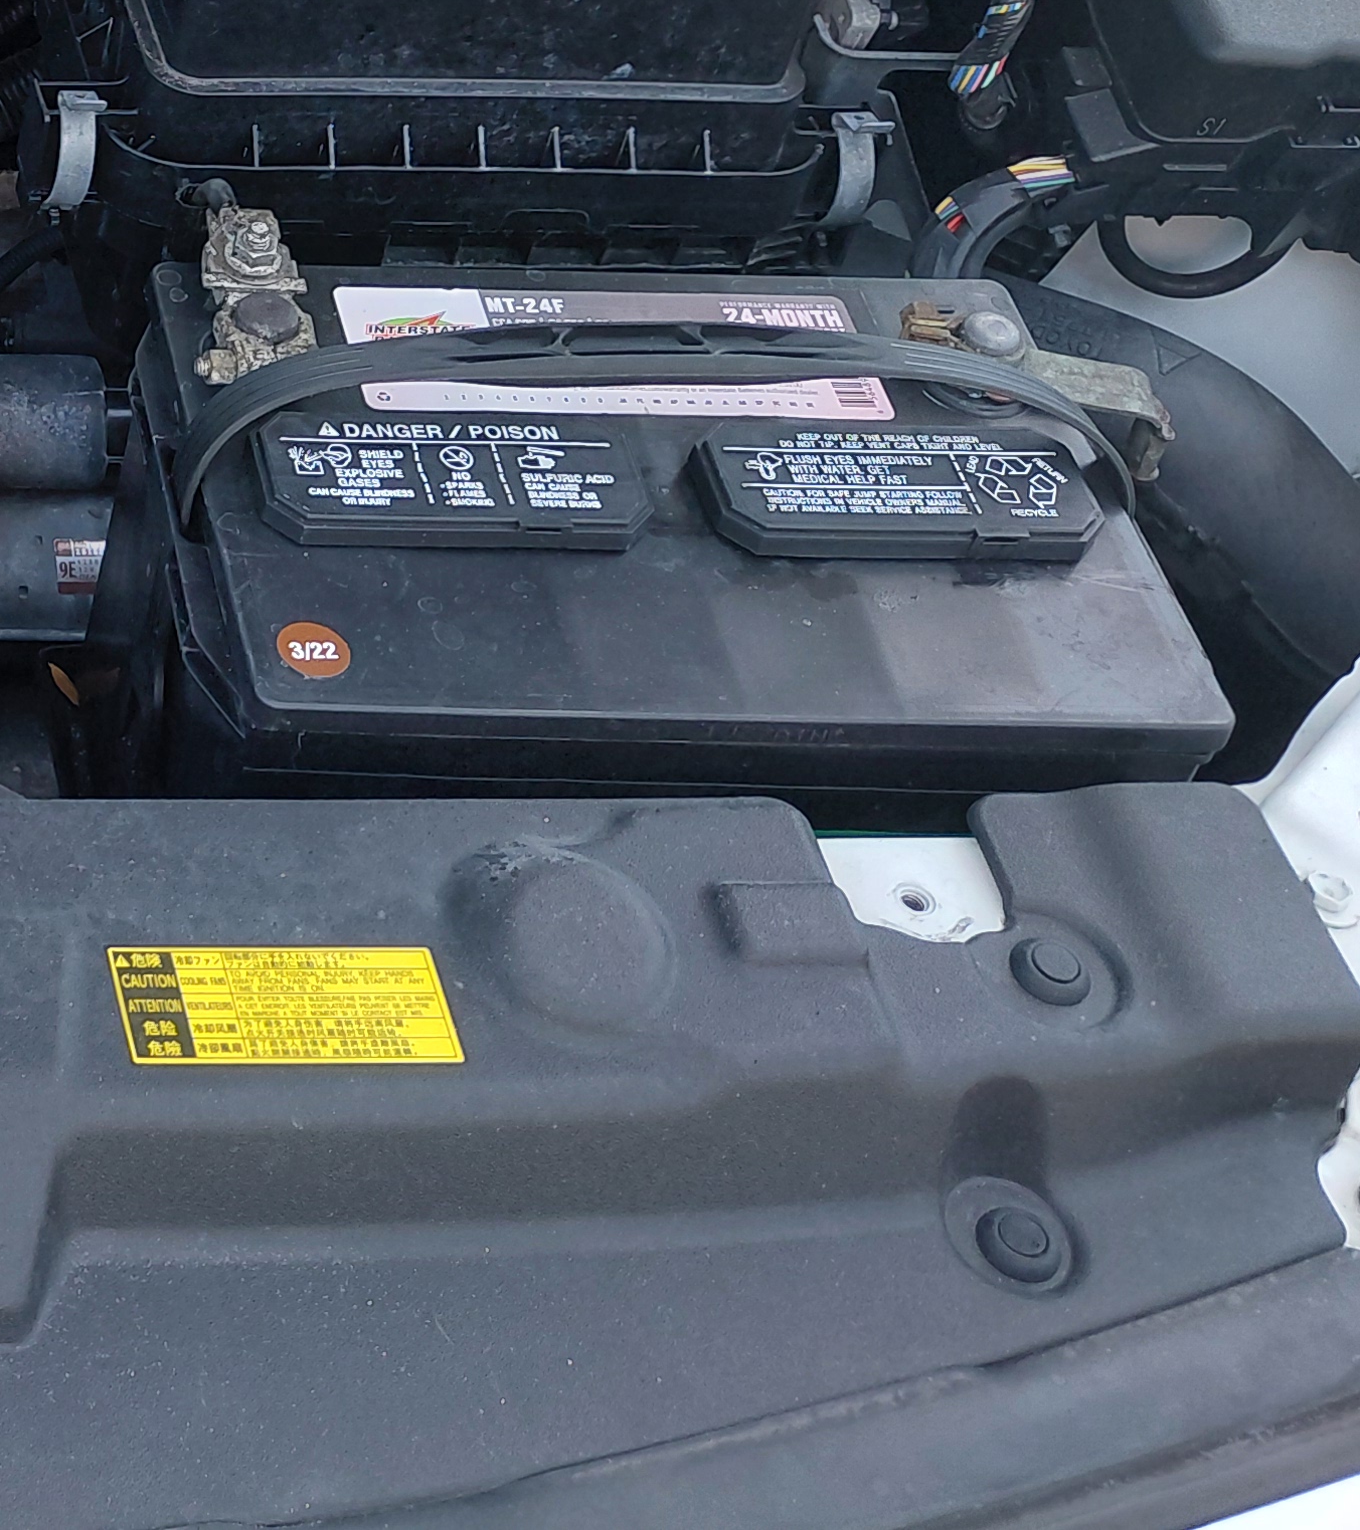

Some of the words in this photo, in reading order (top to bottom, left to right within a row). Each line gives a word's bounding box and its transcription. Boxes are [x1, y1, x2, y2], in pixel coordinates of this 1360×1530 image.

[484, 296, 565, 314] MT-24F
[722, 307, 846, 328] 24-MONTH
[343, 423, 444, 439] DANGER
[468, 425, 560, 440] POISON
[796, 433, 820, 441] KEEP
[823, 433, 842, 441] OUT
[883, 434, 915, 443] REACH
[932, 435, 979, 444] CHILDREN
[779, 440, 794, 448] DO
[797, 440, 817, 448] NOT
[840, 441, 864, 449] KEEP
[358, 450, 404, 459] SHIELD
[783, 454, 821, 465] FLUSH
[824, 455, 854, 465] EYES
[856, 455, 932, 466] IMMEDIATELY
[361, 459, 395, 468] EYES
[335, 469, 405, 478] EXPLOSIVE
[787, 464, 821, 474] WITH
[866, 465, 891, 475] GET
[451, 471, 472, 480] NO
[521, 473, 583, 483] SULFURIC
[585, 474, 616, 484] ACID
[792, 474, 844, 484] MEDICAL
[846, 474, 876, 484] HELP
[878, 474, 908, 485] FAST
[337, 479, 381, 487] GASES
[445, 481, 484, 490] SPARKS
[524, 483, 546, 491] CAN
[308, 488, 329, 496] CAN
[330, 488, 362, 496] CAUSE
[806, 489, 825, 497] FOR
[827, 489, 850, 498] SAFE
[853, 490, 877, 498] JUMP
[1011, 508, 1059, 517] RECYCLE
[288, 641, 340, 661] 3/22
[130, 953, 163, 968] 危険
[175, 955, 221, 966] 冷却ファン
[121, 973, 177, 989] CAUTION
[179, 976, 208, 985] COOLING
[210, 976, 227, 985] FANS
[128, 998, 183, 1013] ATTENTION
[143, 1020, 178, 1036] 危险
